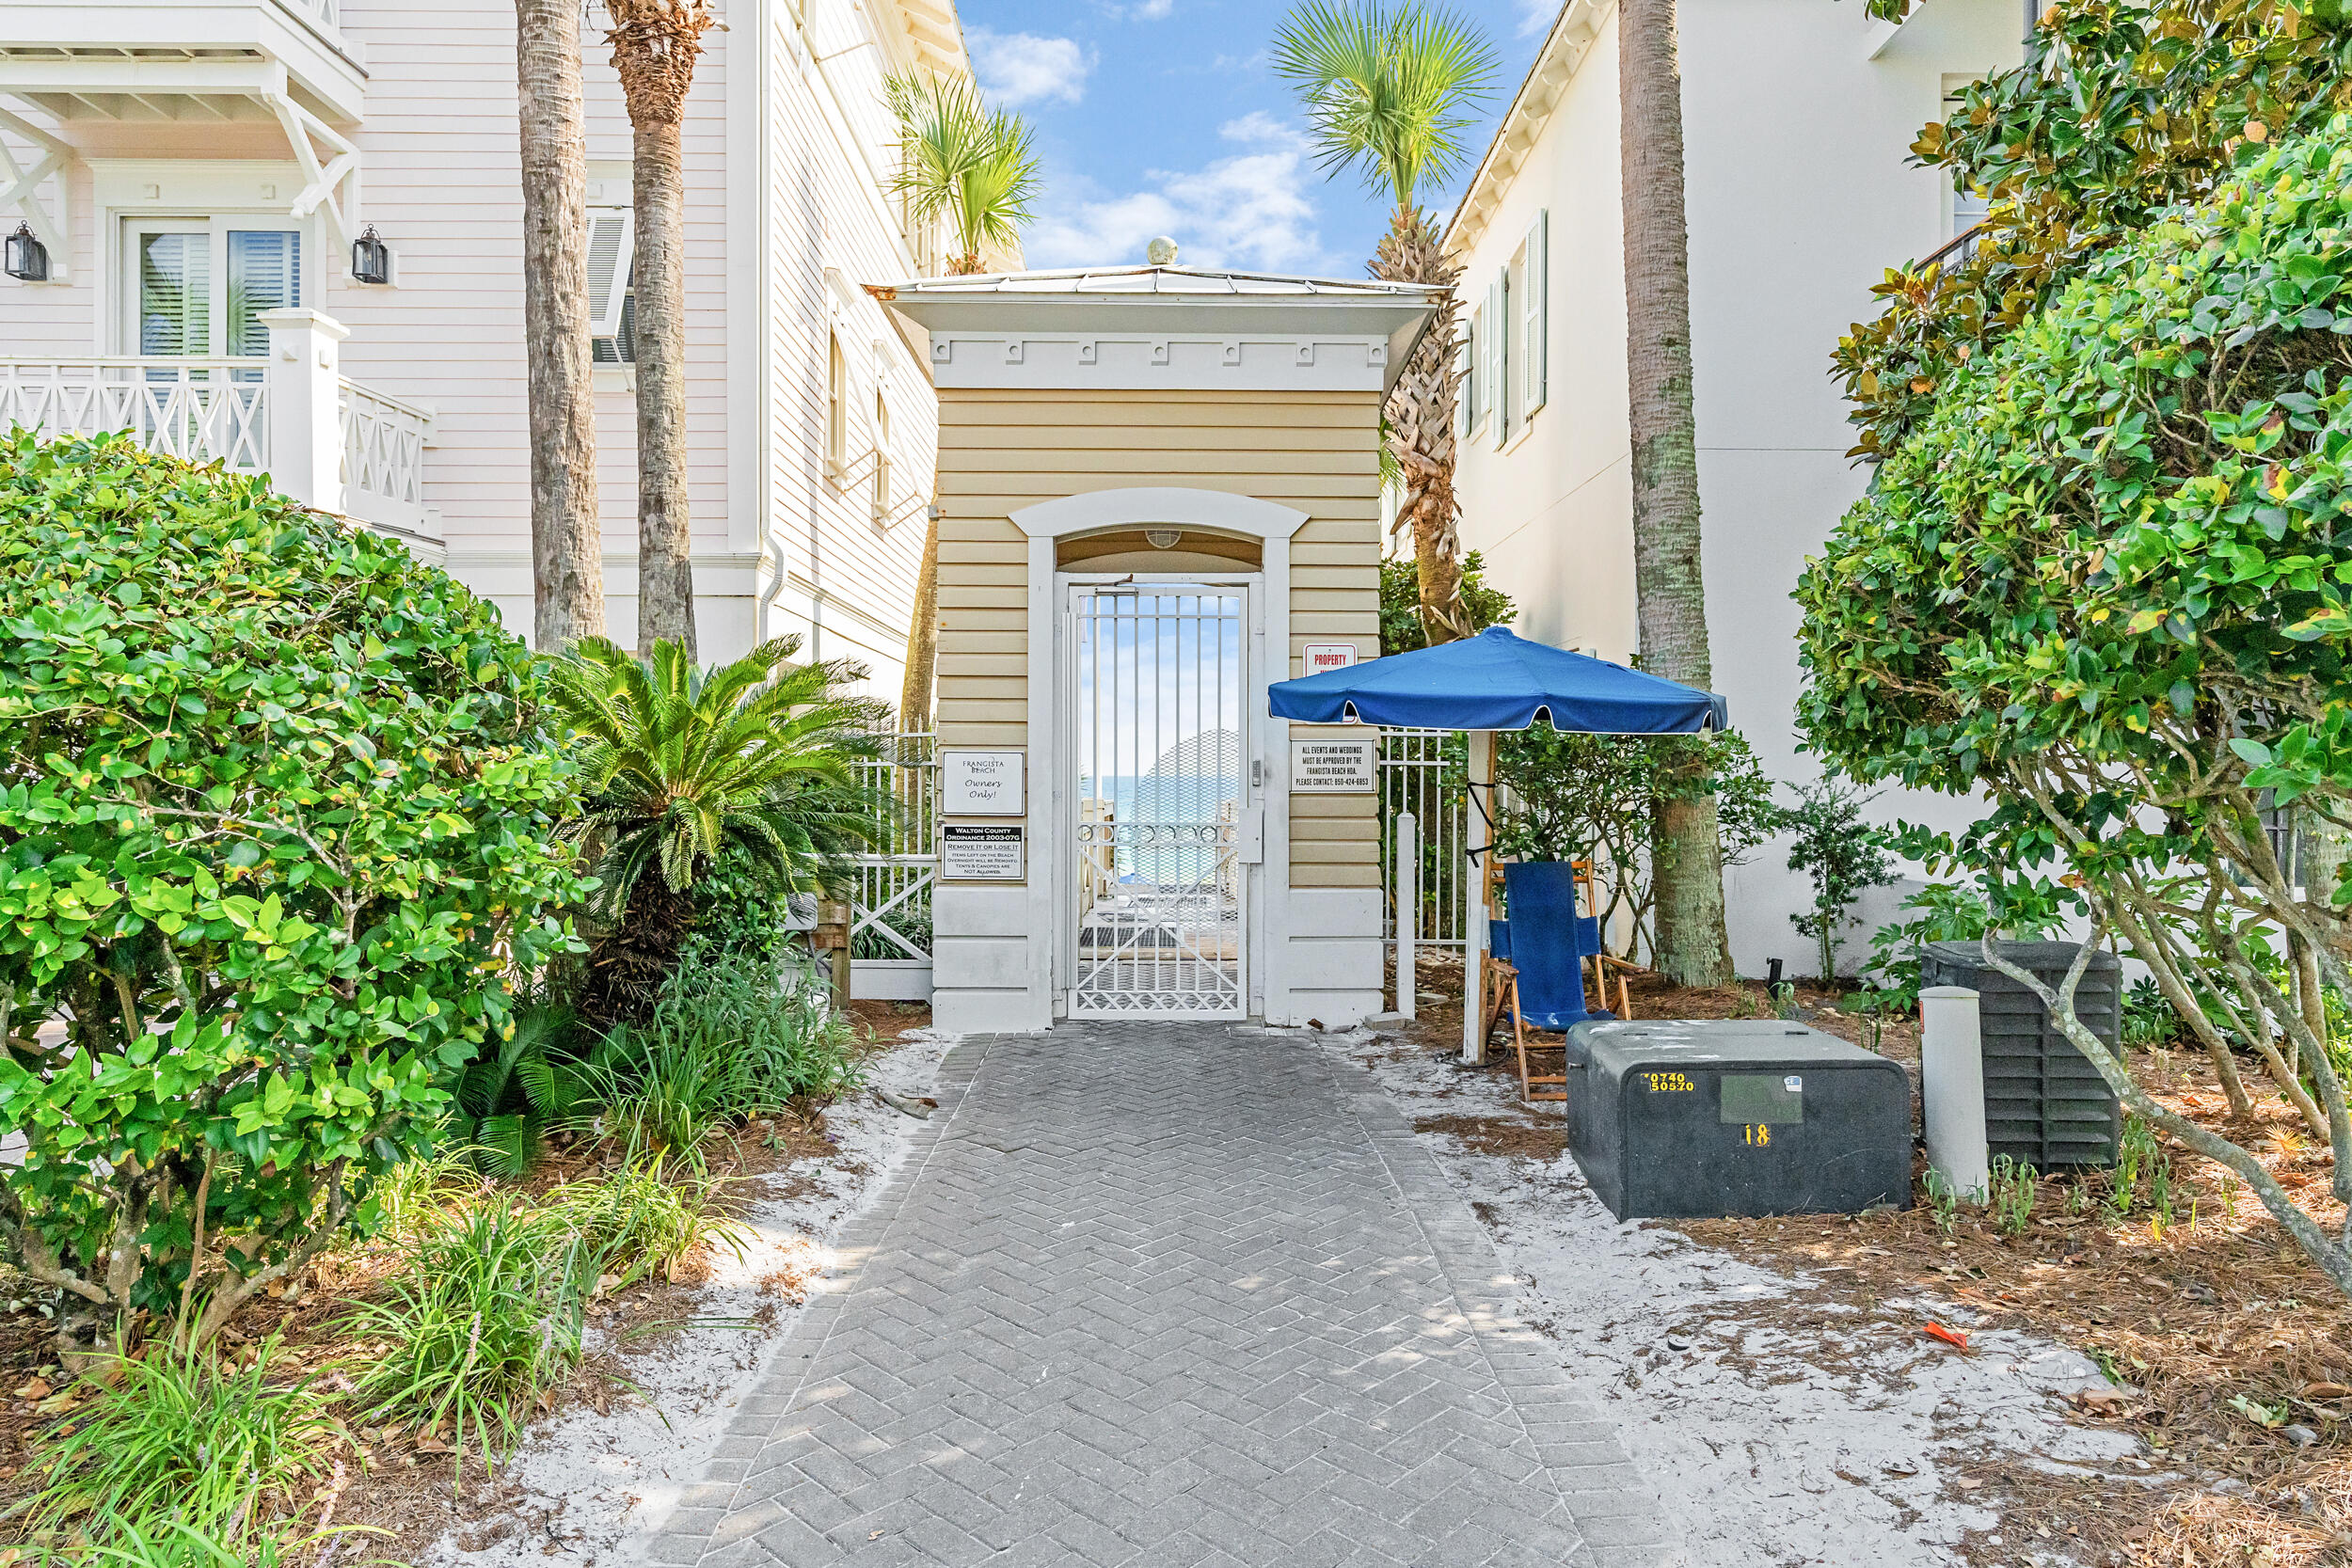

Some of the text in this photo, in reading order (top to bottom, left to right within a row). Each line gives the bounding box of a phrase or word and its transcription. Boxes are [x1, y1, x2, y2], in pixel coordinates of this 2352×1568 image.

[1314, 655, 1346, 665] PROPERTY
[969, 790, 996, 800] Only!
[1650, 1073, 1685, 1082] 0740
